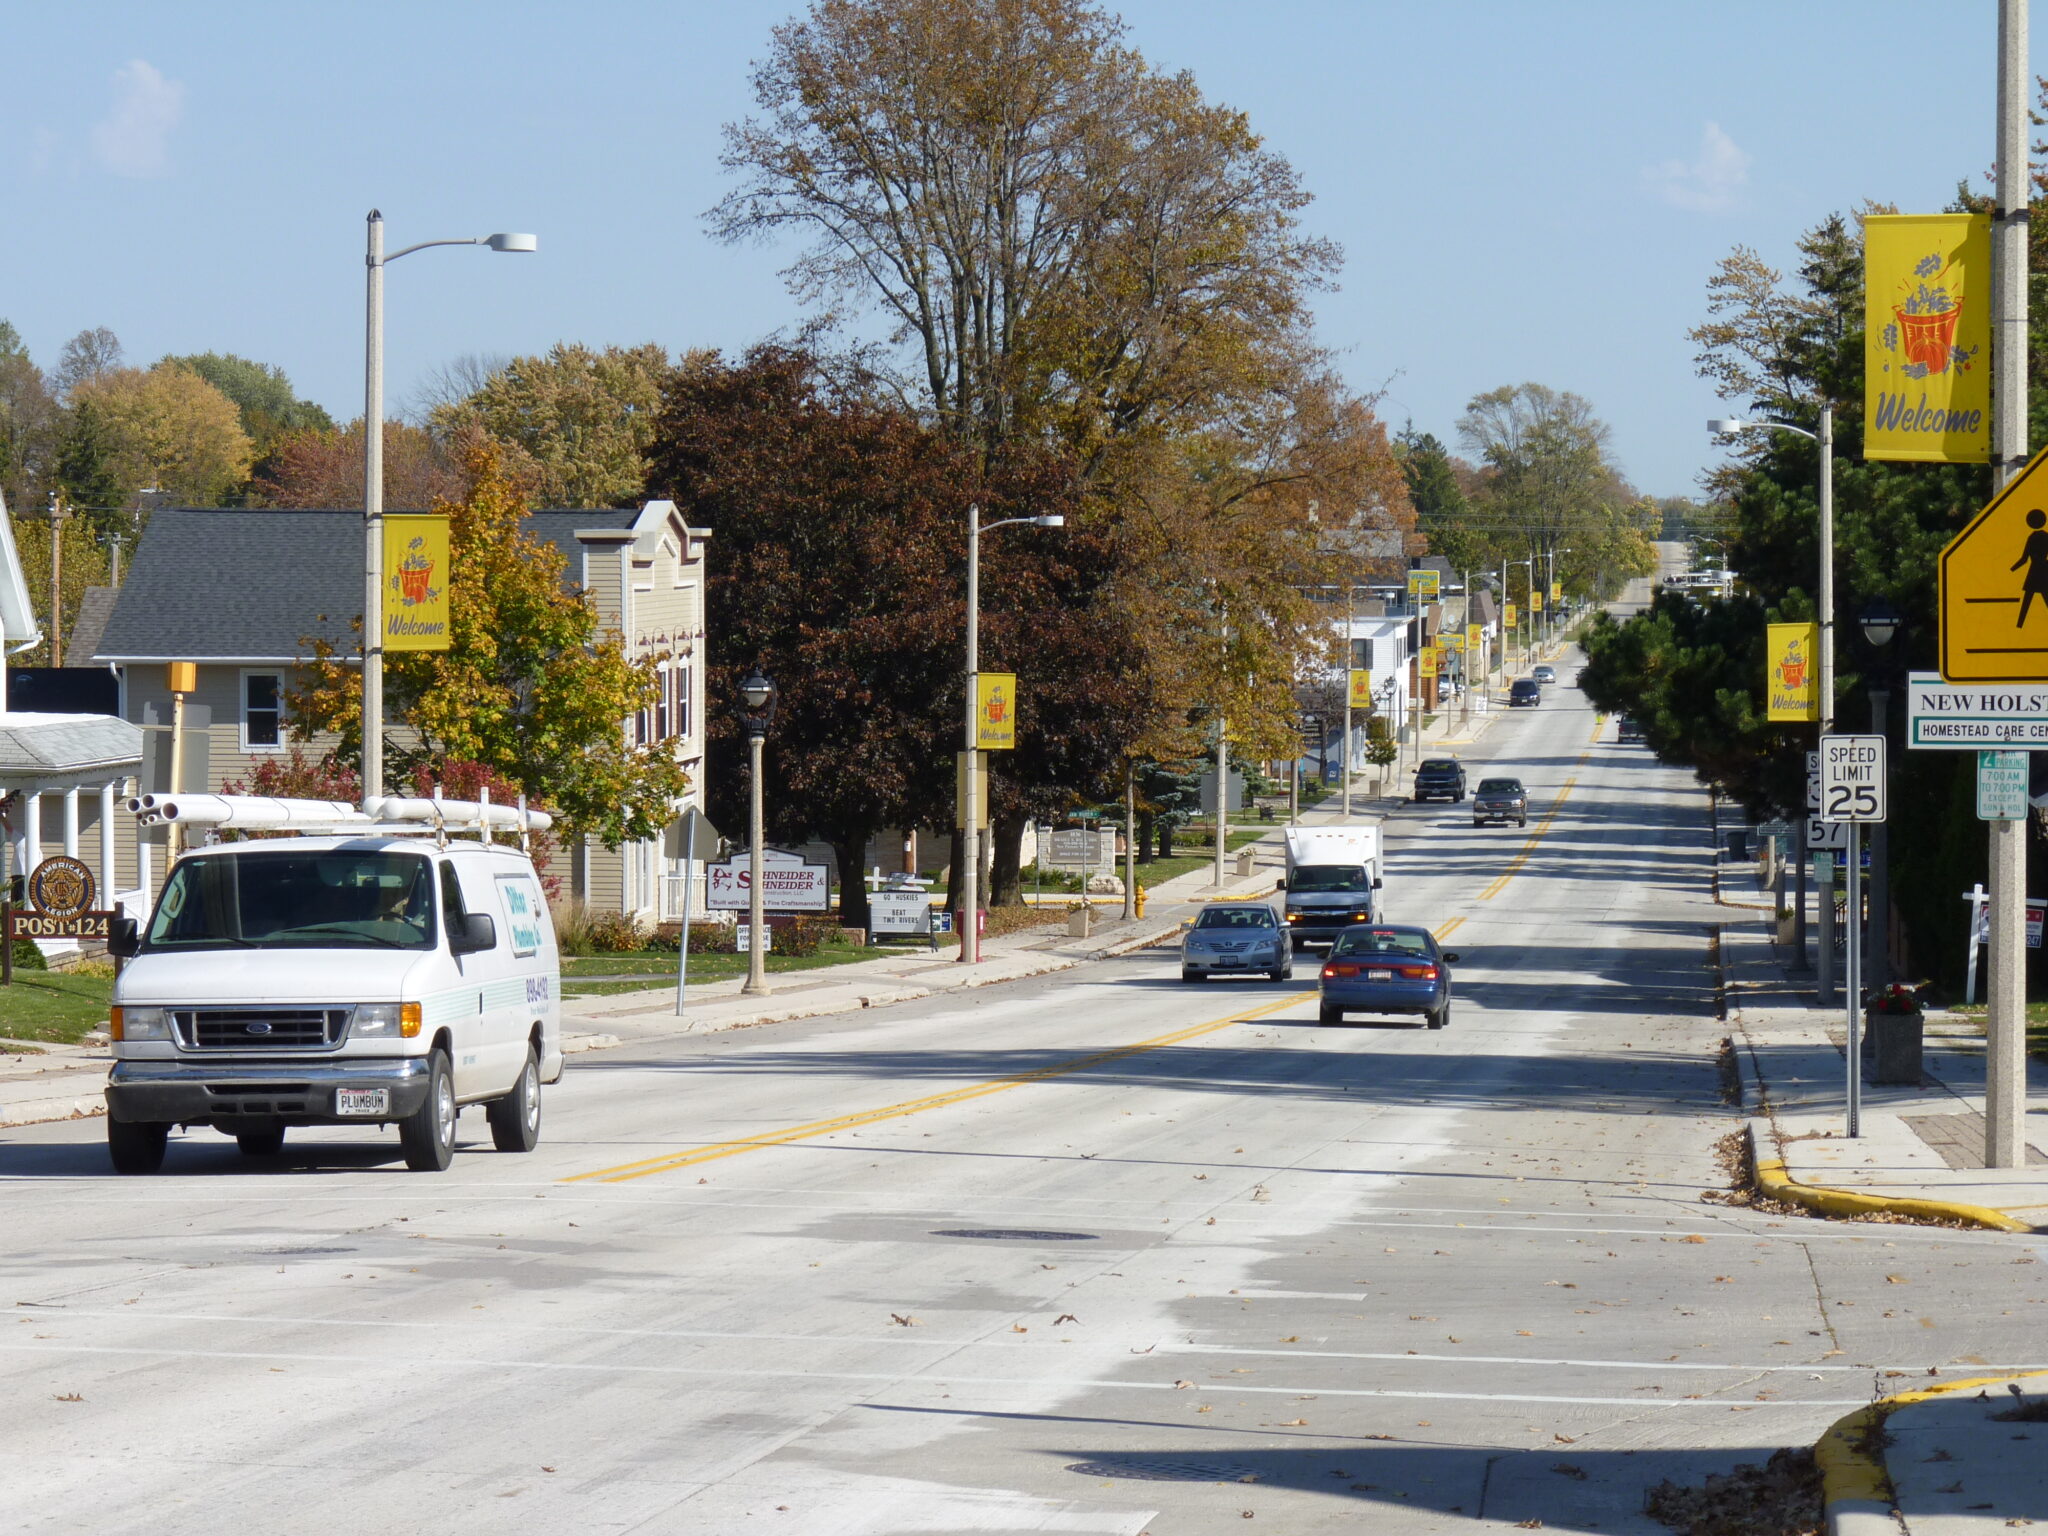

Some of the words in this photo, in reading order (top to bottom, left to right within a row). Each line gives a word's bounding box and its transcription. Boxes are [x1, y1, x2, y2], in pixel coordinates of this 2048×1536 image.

[1875, 391, 1982, 434] Welcome
[387, 613, 445, 636] Welcome
[1772, 693, 1816, 710] Welcome
[1920, 694, 1973, 711] NEW
[980, 727, 1012, 741] Welcome
[1922, 724, 1990, 737] HOMESTEAD
[1995, 725, 2025, 737] CARE
[1829, 747, 1876, 763] SPEED
[1996, 758, 2025, 767] PARKING
[1833, 765, 1873, 781] LIMIT
[2007, 771, 2020, 780] AM
[1981, 782, 1991, 792] TO
[2012, 783, 2025, 792] PM
[1828, 785, 1878, 816] 25
[1988, 794, 2017, 803] EXCEPT
[1983, 803, 1998, 812] SUN
[2007, 804, 2022, 812] HOL
[1811, 821, 1841, 842] 57
[40, 862, 86, 880] AMERICAN
[736, 871, 814, 889] SHNEIDER
[817, 877, 825, 886] &
[46, 906, 78, 917] LEGION
[341, 1095, 384, 1108] PLUMBUM
